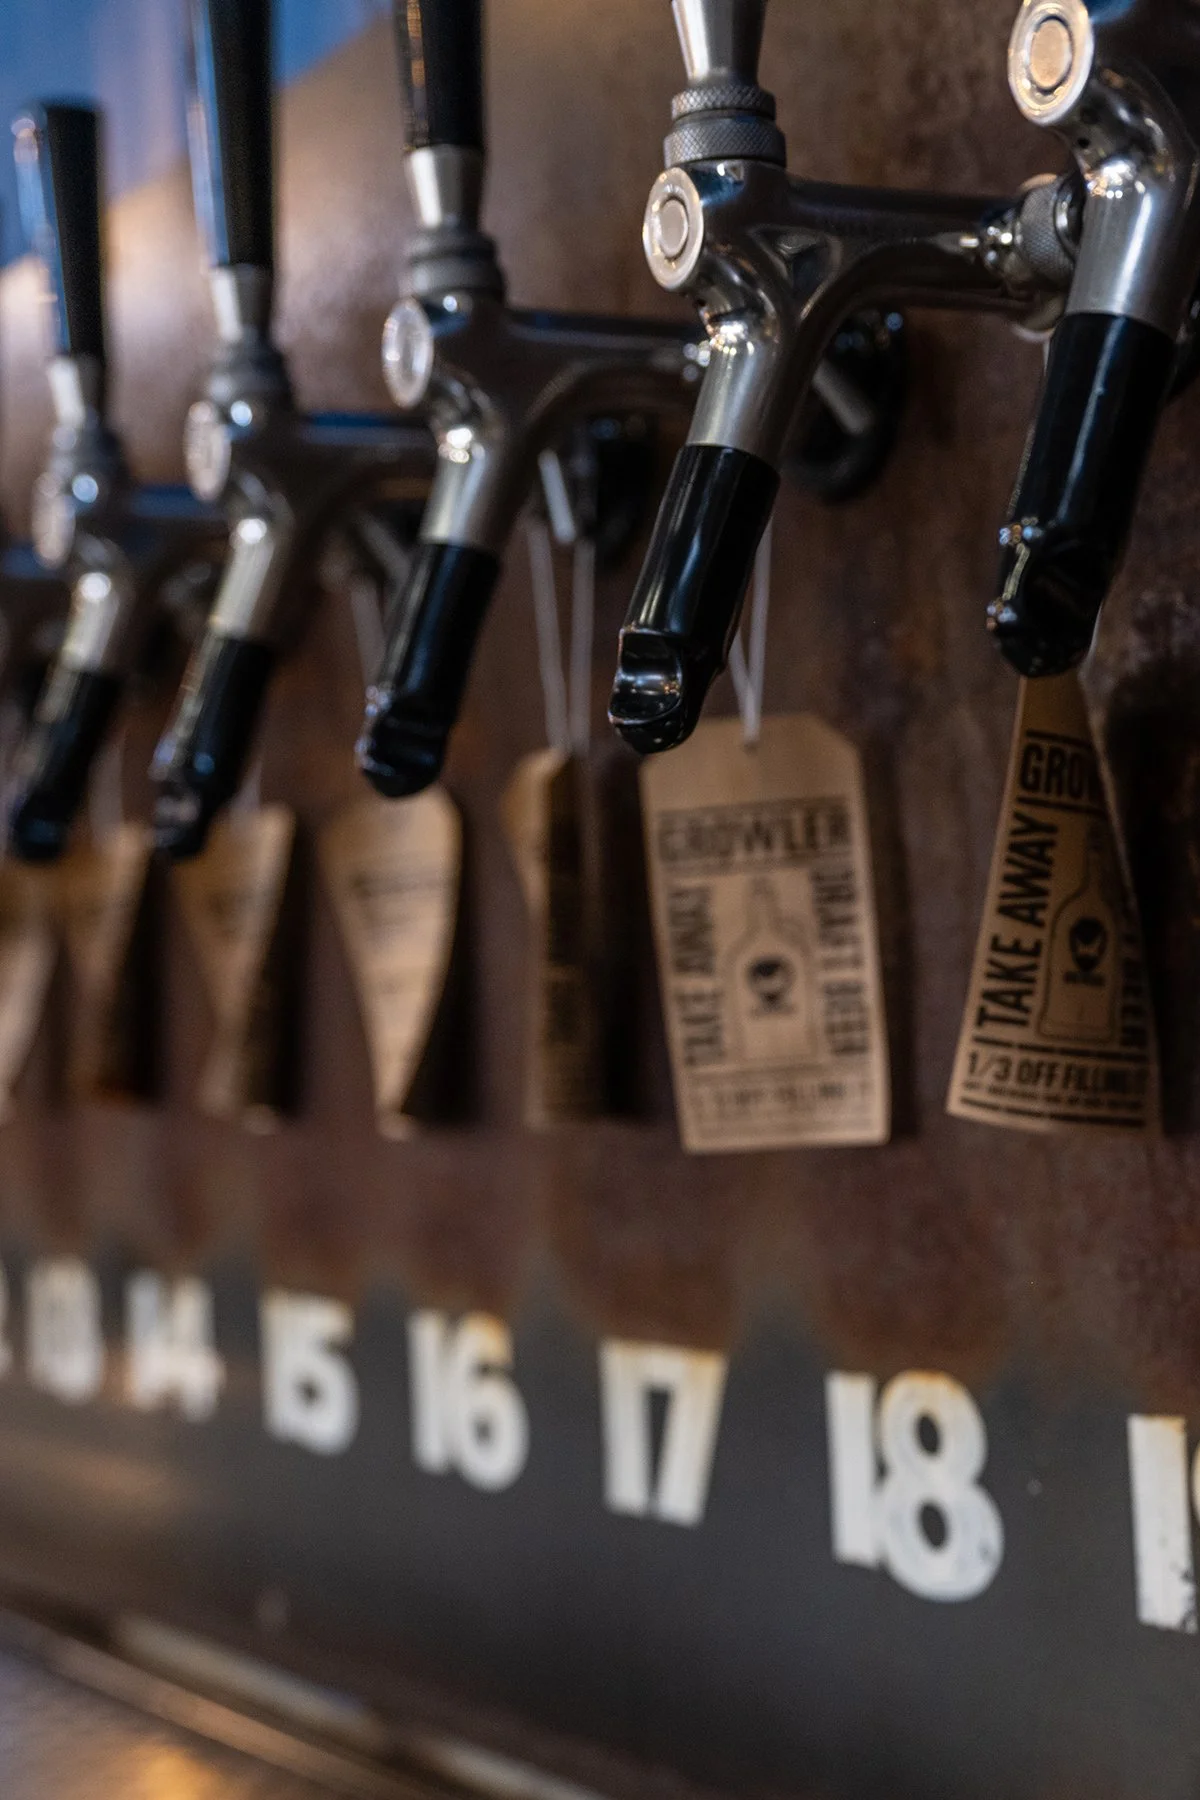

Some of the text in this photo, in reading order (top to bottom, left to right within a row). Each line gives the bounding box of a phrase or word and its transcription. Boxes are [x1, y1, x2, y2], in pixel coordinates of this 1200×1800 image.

[1020, 742, 1102, 802] GRO
[978, 810, 1059, 1028] TAKE AWAY
[258, 1290, 360, 1456] 15
[405, 1306, 530, 1493] 16
[598, 1334, 727, 1528] 17
[824, 1368, 1004, 1601] 18
